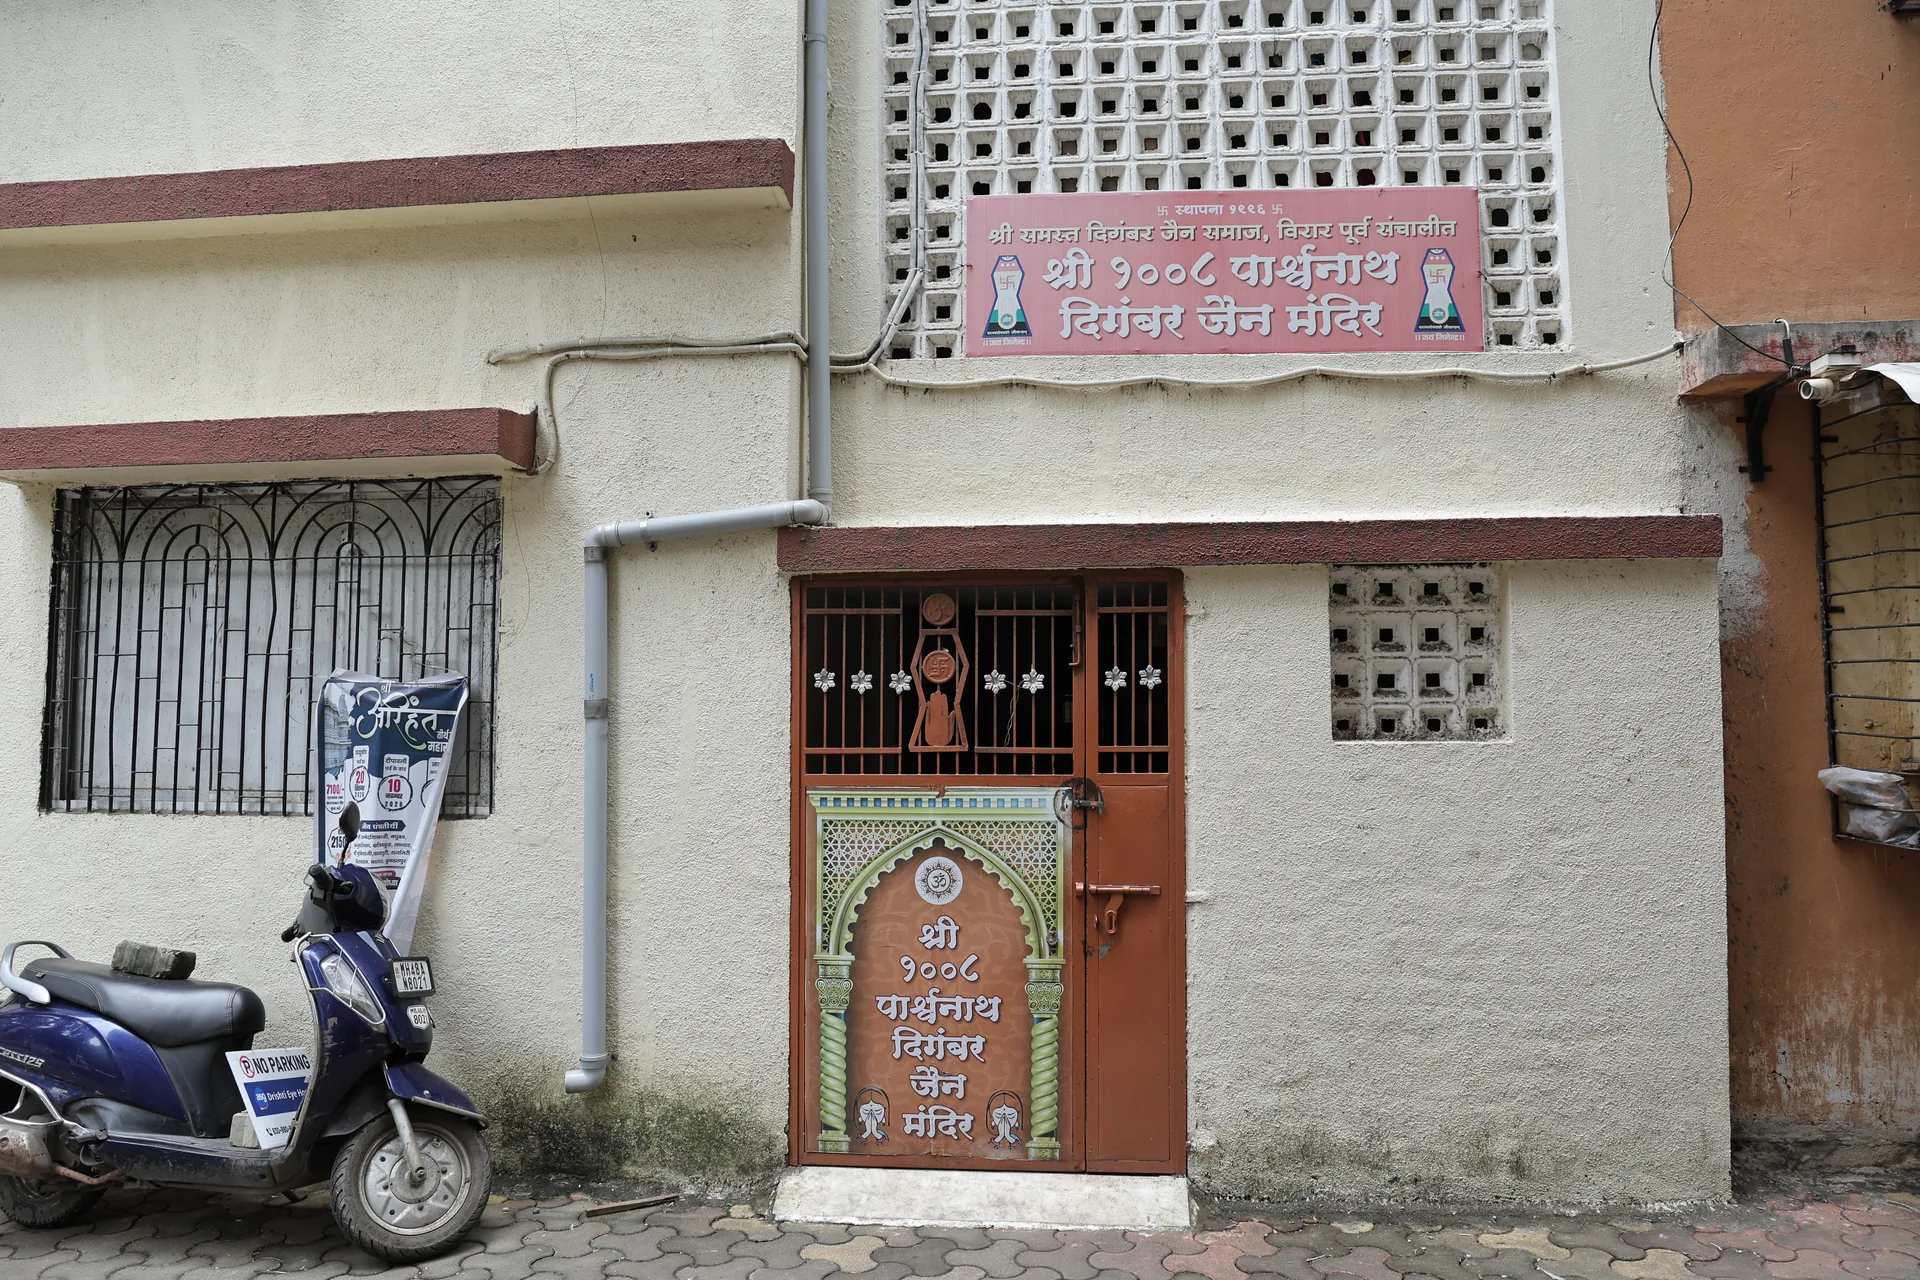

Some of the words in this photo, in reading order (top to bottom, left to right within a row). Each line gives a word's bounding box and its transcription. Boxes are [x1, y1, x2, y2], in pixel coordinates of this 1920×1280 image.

[1175, 204, 1224, 215] स्थापना
[1230, 204, 1266, 215] १९९६
[988, 221, 1014, 245] श्री
[1019, 227, 1081, 244] समस्त
[1086, 219, 1155, 243] दिगंबर
[1160, 219, 1196, 242] जैन
[1202, 223, 1270, 243] समाज,
[1277, 217, 1333, 240] विरार
[1339, 215, 1372, 245] पूर्व
[1376, 214, 1457, 238] संचालीत
[1042, 247, 1095, 291] श्री
[1110, 251, 1217, 291] १००८
[1229, 244, 1401, 292] पार्श्वनाथ
[1058, 295, 1186, 341] दिगंबर
[1196, 294, 1275, 338] जैन
[1285, 293, 1384, 338] मंदिर
[388, 779, 401, 793] 10
[917, 915, 960, 950] श्री
[400, 962, 426, 977] MH48A
[899, 954, 980, 983] १००८
[875, 988, 1002, 1025] पार्श्वनाथ
[892, 1026, 986, 1062] दिगंबर
[253, 1057, 269, 1075] NO
[268, 1054, 311, 1073] PARKING
[267, 1090, 288, 1101] Drishti
[287, 1089, 298, 1100] Eye
[909, 1066, 968, 1100] जैन
[902, 1104, 974, 1141] मंदिर
